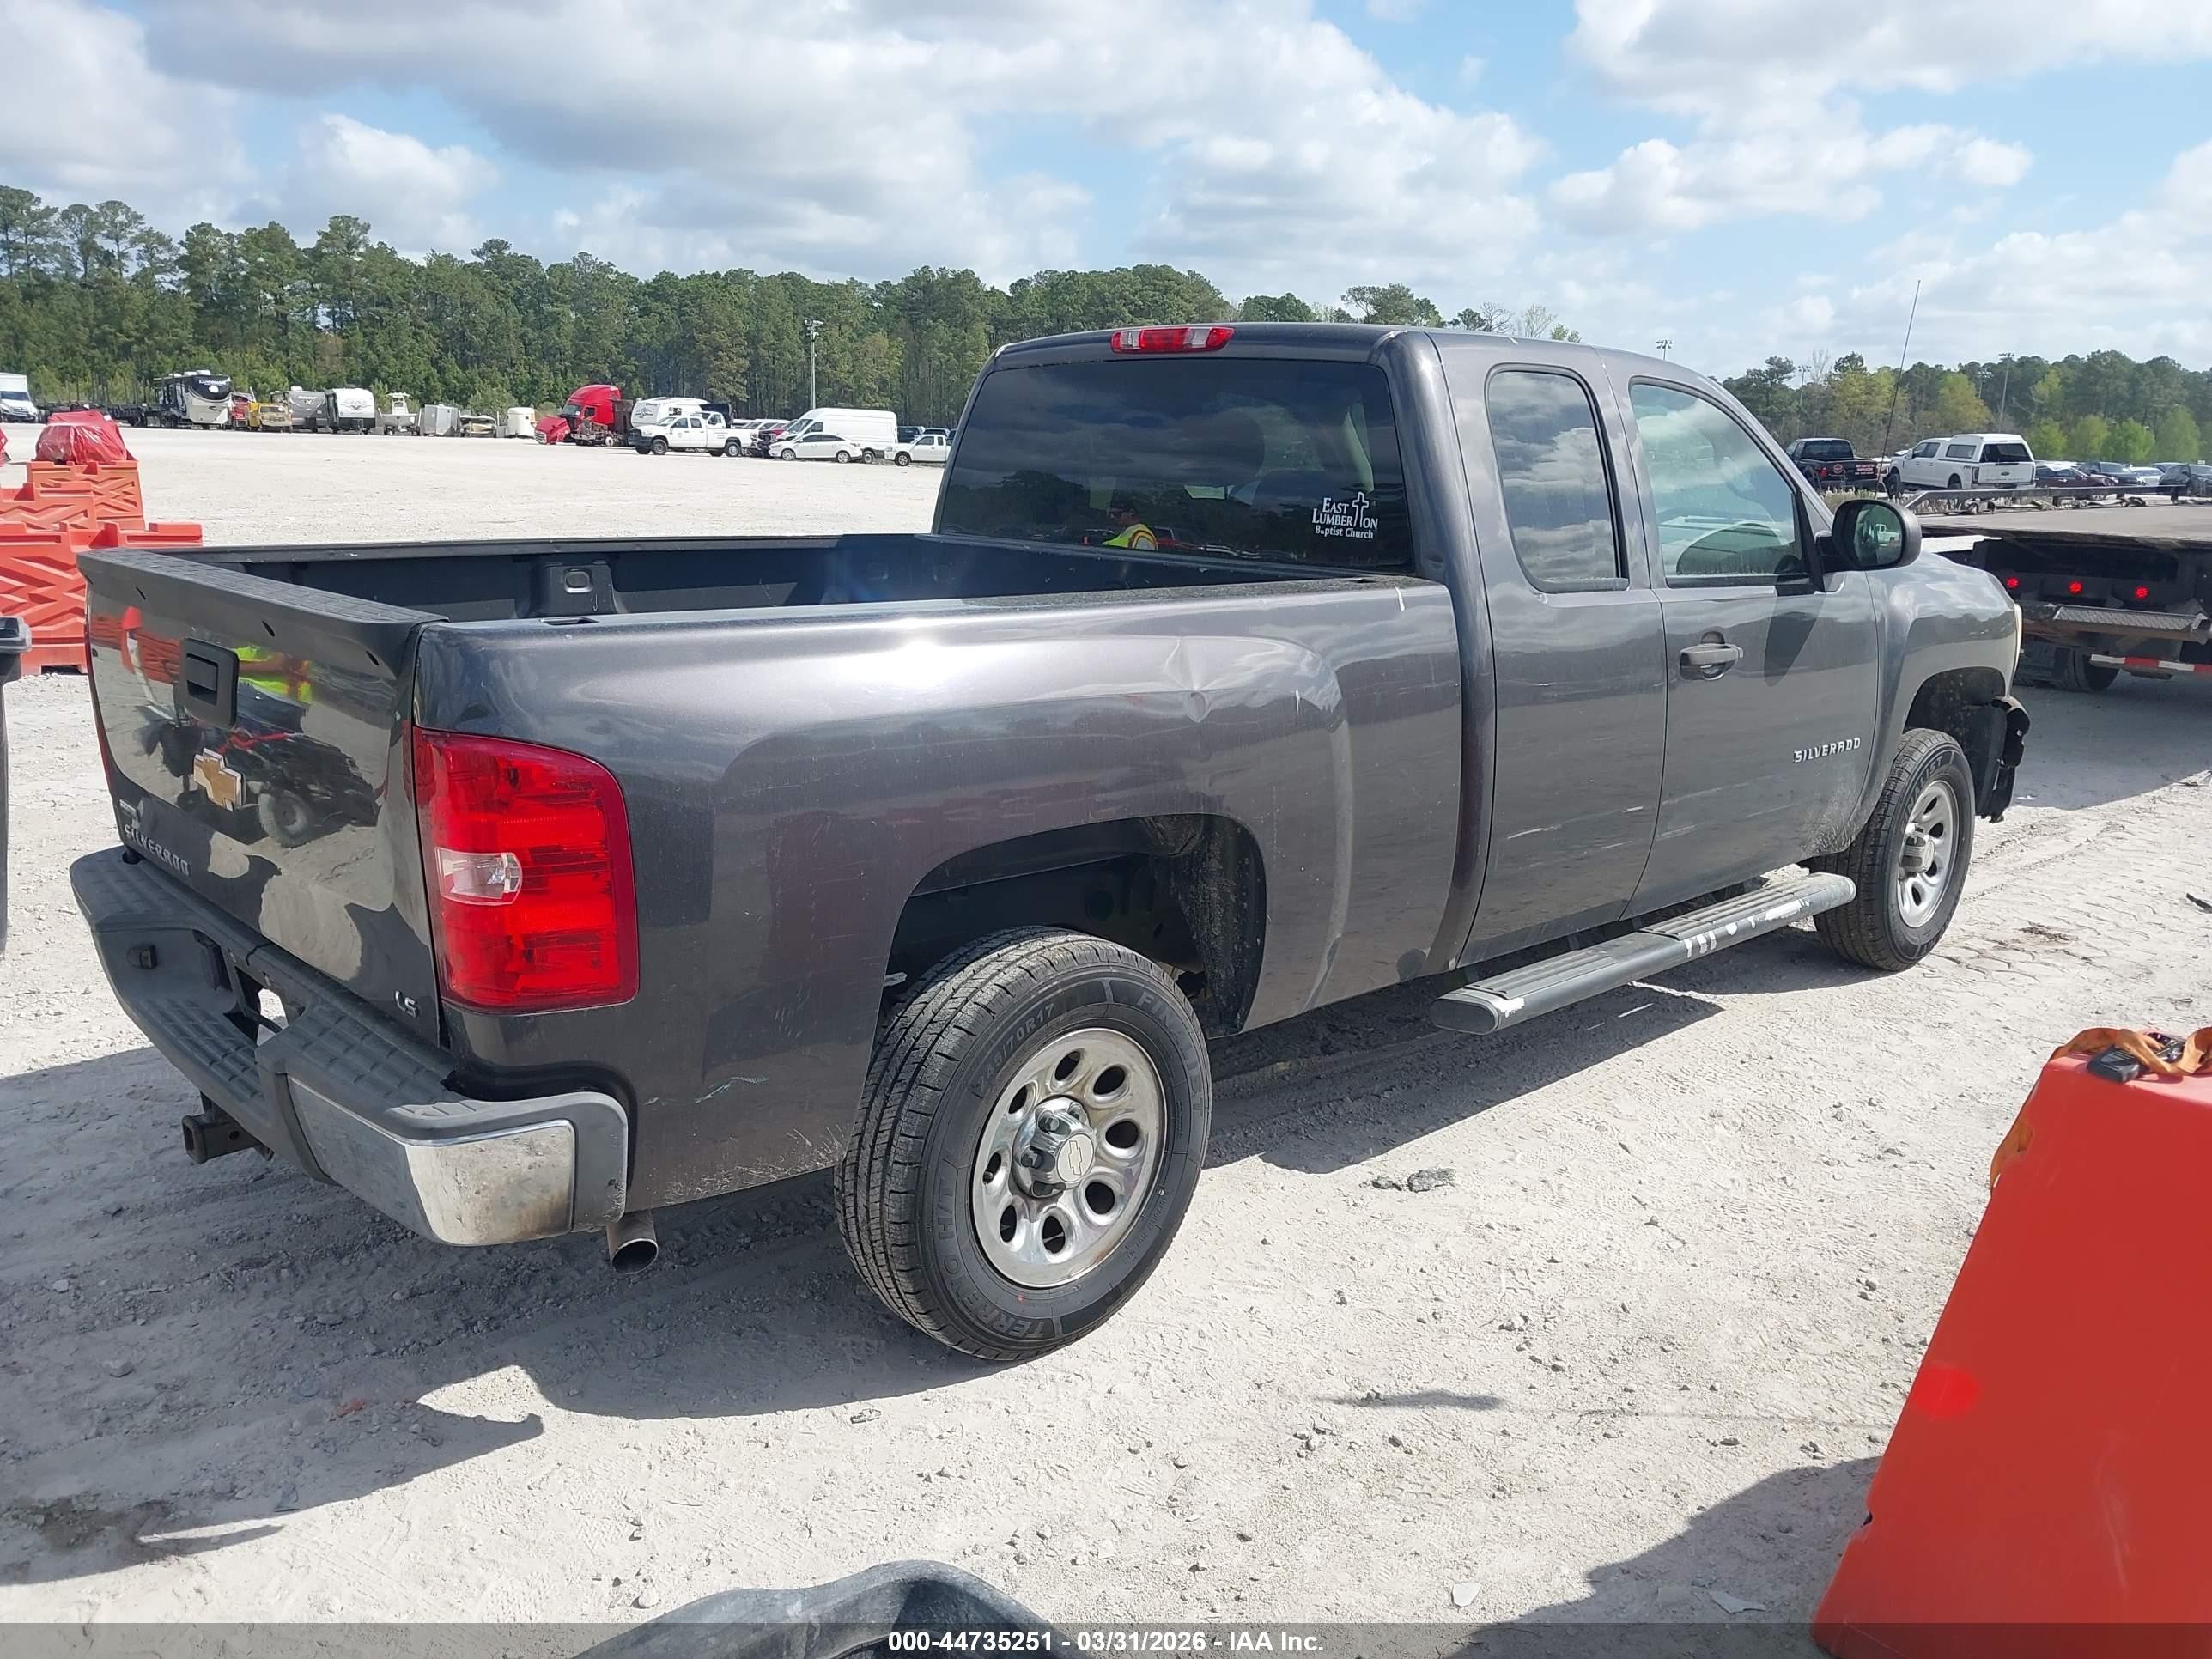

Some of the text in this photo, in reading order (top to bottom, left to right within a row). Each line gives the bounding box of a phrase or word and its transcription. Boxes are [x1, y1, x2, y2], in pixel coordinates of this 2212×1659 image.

[1322, 497, 1349, 515] EAST
[1316, 526, 1374, 539] Baptist Church
[1793, 737, 1861, 763] SILVERADO
[124, 823, 190, 876] SILVERADO
[395, 990, 417, 1018] LS
